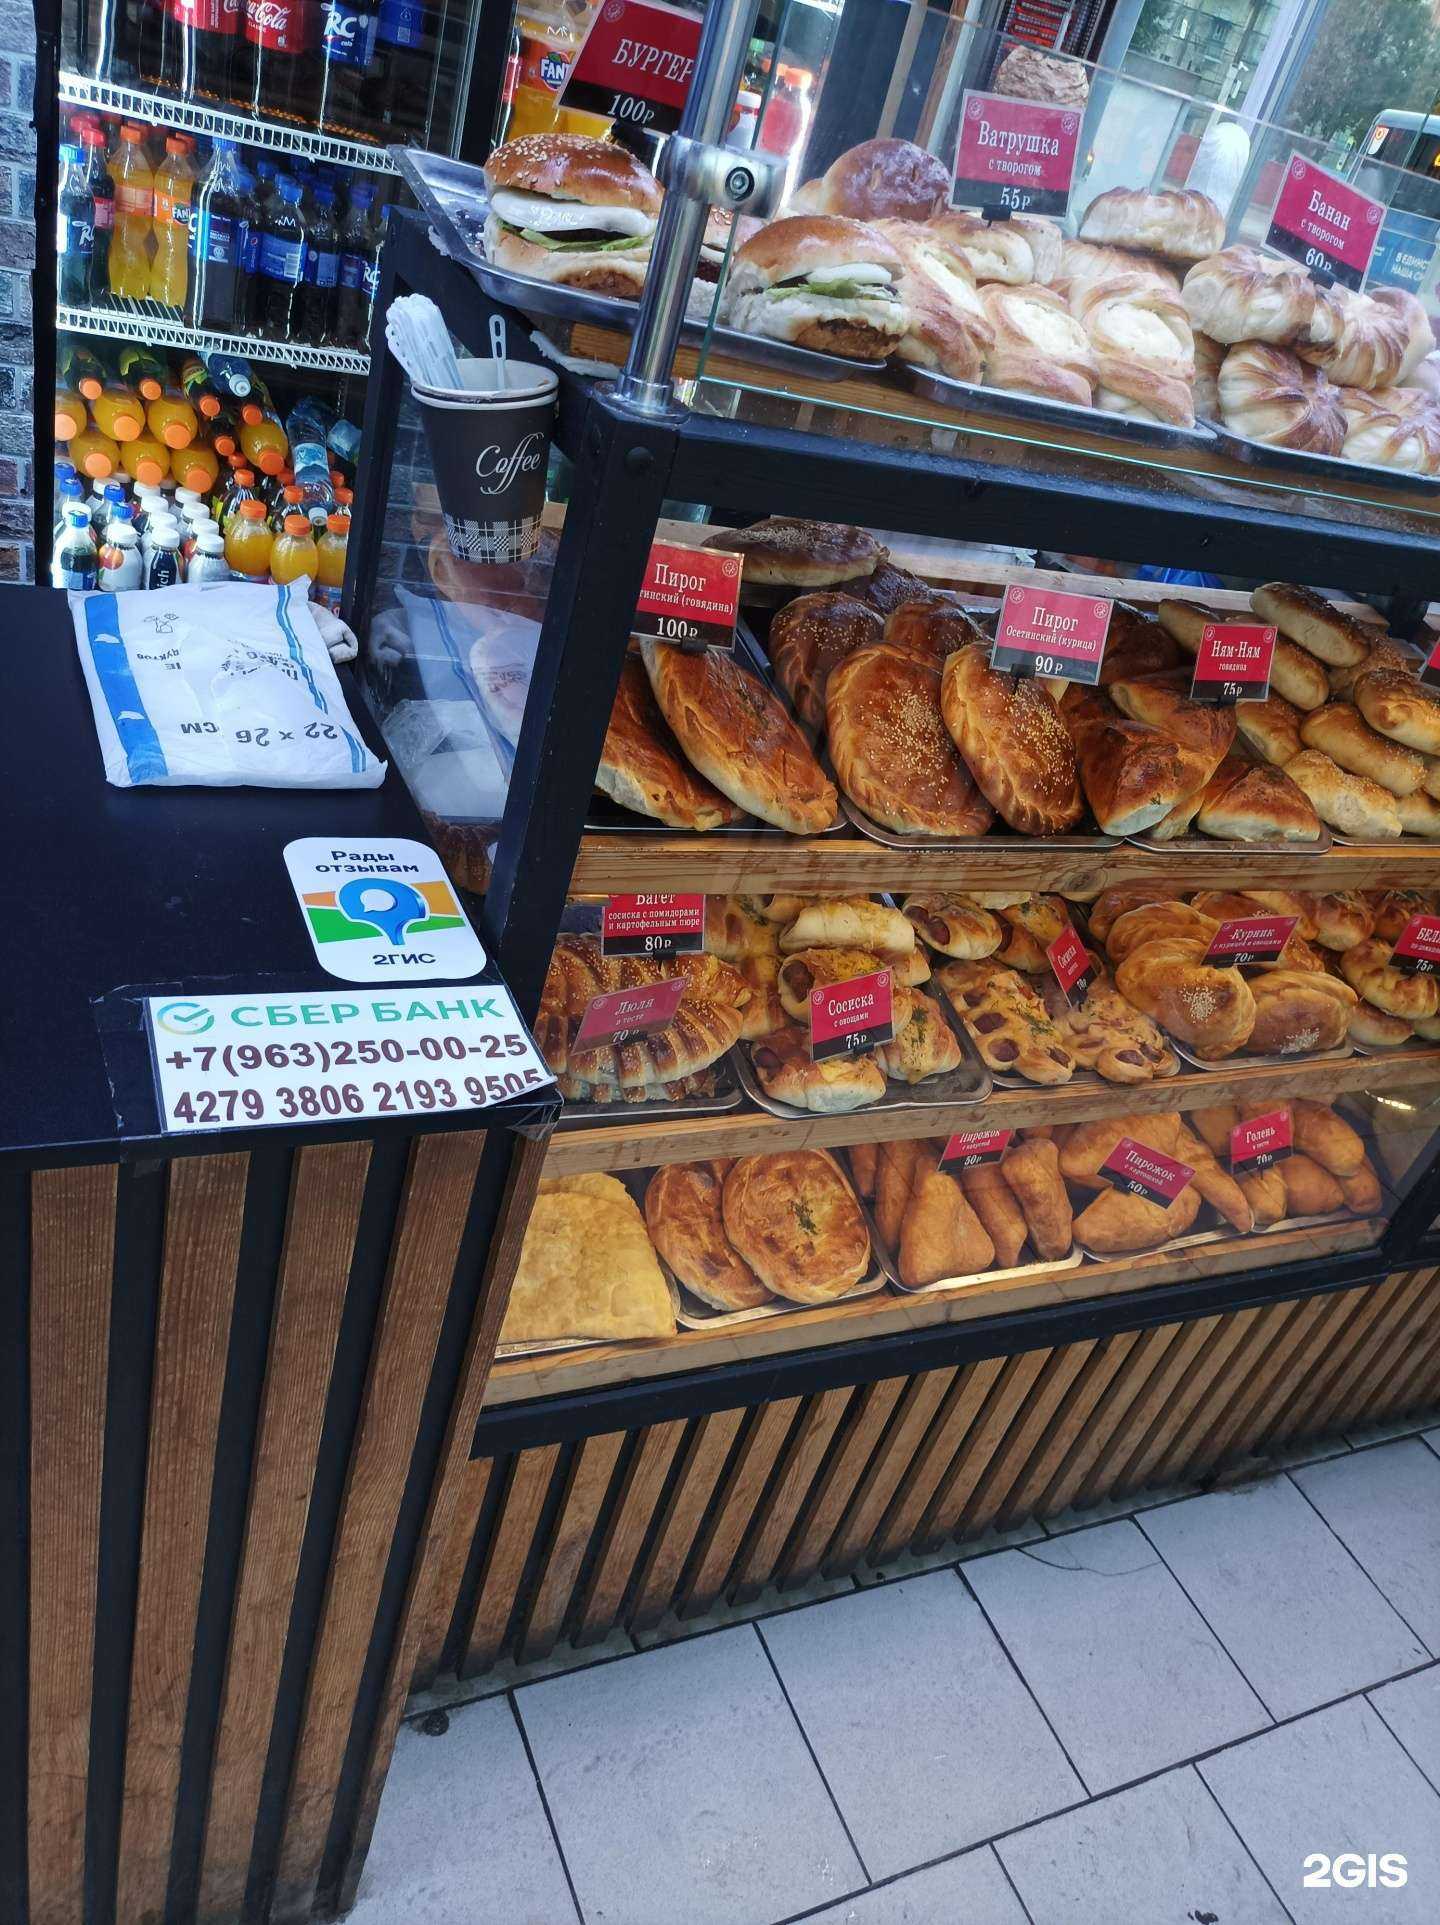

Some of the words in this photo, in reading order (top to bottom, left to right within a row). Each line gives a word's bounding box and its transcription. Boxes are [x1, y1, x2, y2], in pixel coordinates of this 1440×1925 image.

[324, 11, 357, 38] RC
[977, 120, 1059, 156] Ватрушка
[988, 159, 994, 170] с
[996, 159, 1042, 177] творогом
[1308, 189, 1351, 231] Банан
[1300, 218, 1306, 228] с
[1307, 221, 1345, 250] творогом
[476, 432, 545, 495] Coffee
[654, 563, 707, 593] Пирог
[681, 594, 733, 616] (говядина)
[1032, 606, 1079, 633] Пирог
[1006, 625, 1057, 644] Осетинский
[1058, 634, 1096, 652] (курица)
[1211, 640, 1261, 658] Ням-Ням
[235, 728, 271, 748] 26
[303, 722, 338, 740] 22
[331, 850, 395, 863] Рады
[315, 864, 420, 873] отзывам
[608, 911, 641, 920] сосиска
[642, 911, 648, 919] с
[649, 908, 700, 919] помидорами
[616, 919, 677, 932] картофельным
[679, 917, 700, 928] пюре
[1231, 928, 1276, 941] Курник
[1416, 927, 1440, 943] БЕЛ
[372, 953, 437, 966] 2ГИС
[231, 1003, 360, 1027] СБЕР
[371, 998, 505, 1023] БАНК
[828, 993, 874, 1016] Сосиска
[165, 1034, 528, 1078] +7(963)250-00-25
[174, 1088, 265, 1124] 4279
[276, 1083, 365, 1119] 3806
[373, 1078, 458, 1112] 2193
[1246, 1126, 1276, 1144] Голень
[1125, 1150, 1176, 1182] Пирожок
